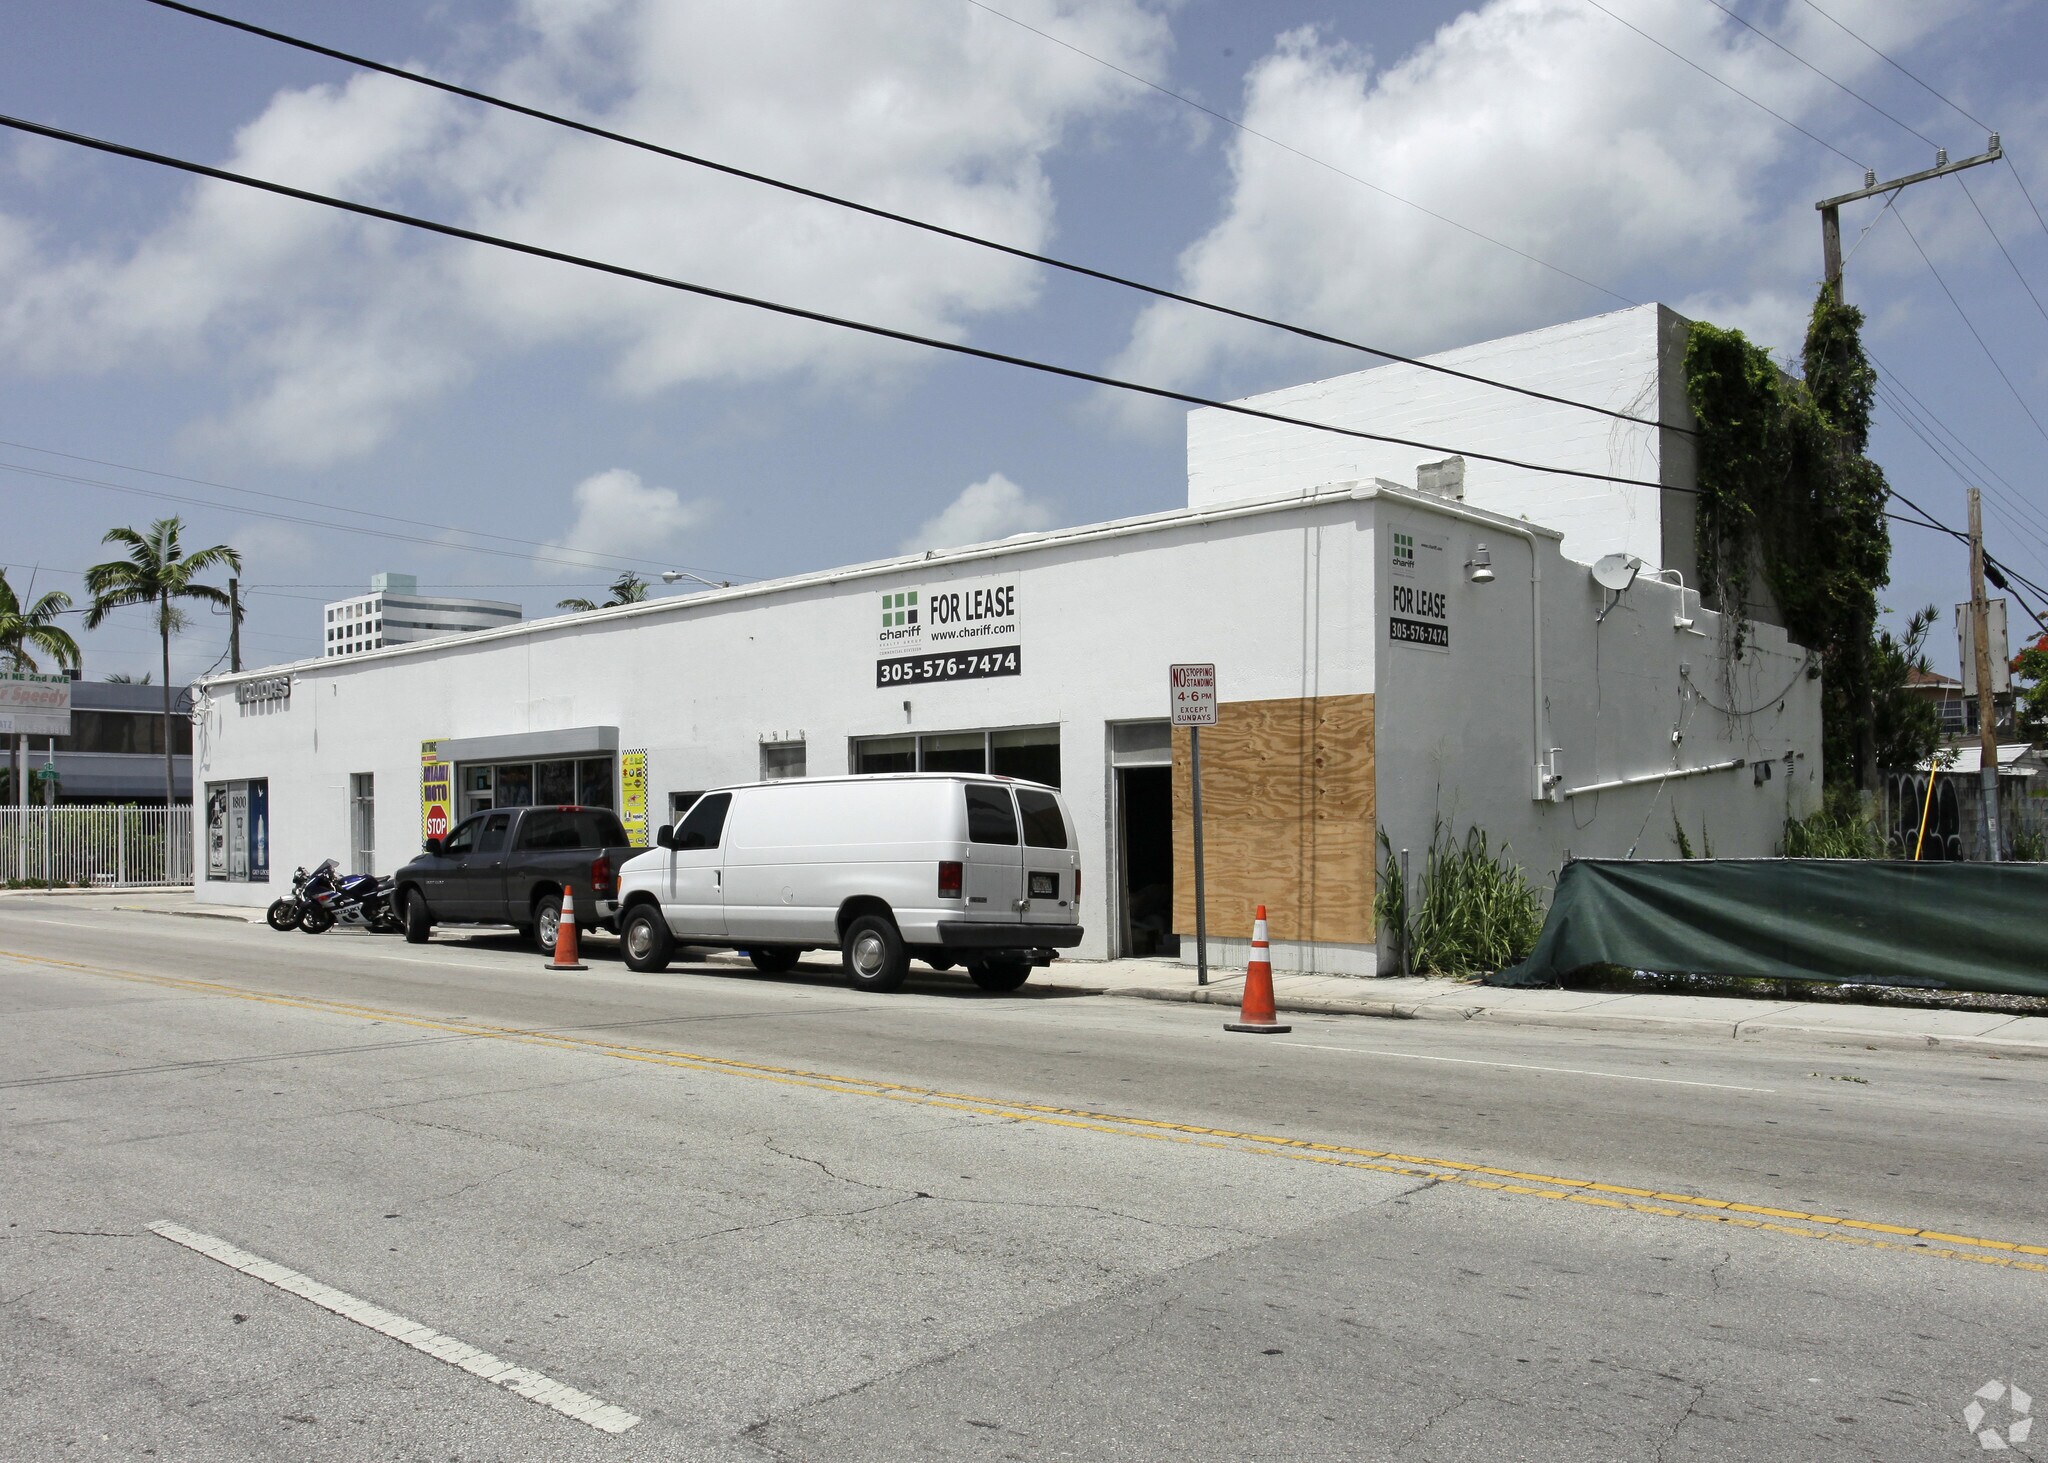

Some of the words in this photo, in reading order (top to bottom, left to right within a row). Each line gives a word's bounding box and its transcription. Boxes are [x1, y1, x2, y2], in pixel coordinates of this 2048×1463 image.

[1392, 558, 1415, 568] chariff
[930, 593, 961, 625] FOR
[965, 585, 1015, 621] LEASE
[1393, 585, 1413, 614] FOR
[1416, 589, 1446, 619] LEASE
[879, 625, 921, 641] chariff
[931, 624, 1015, 641] www.chariff.com
[1391, 622, 1447, 644] 305-576-7474
[880, 652, 1017, 683] 305-576-7474
[12, 673, 25, 681] NE
[29, 674, 47, 682] 2nd
[51, 675, 70, 684] AVE
[1173, 668, 1187, 688] NO
[1186, 668, 1213, 677] STOPPING
[1186, 678, 1213, 687] STANDING
[11, 686, 69, 706] Speedy
[423, 764, 449, 782] MIAMI
[425, 784, 448, 801] MOTO
[232, 796, 247, 808] 1800
[427, 818, 446, 834] STOP
[334, 906, 361, 916] SUZUKI
